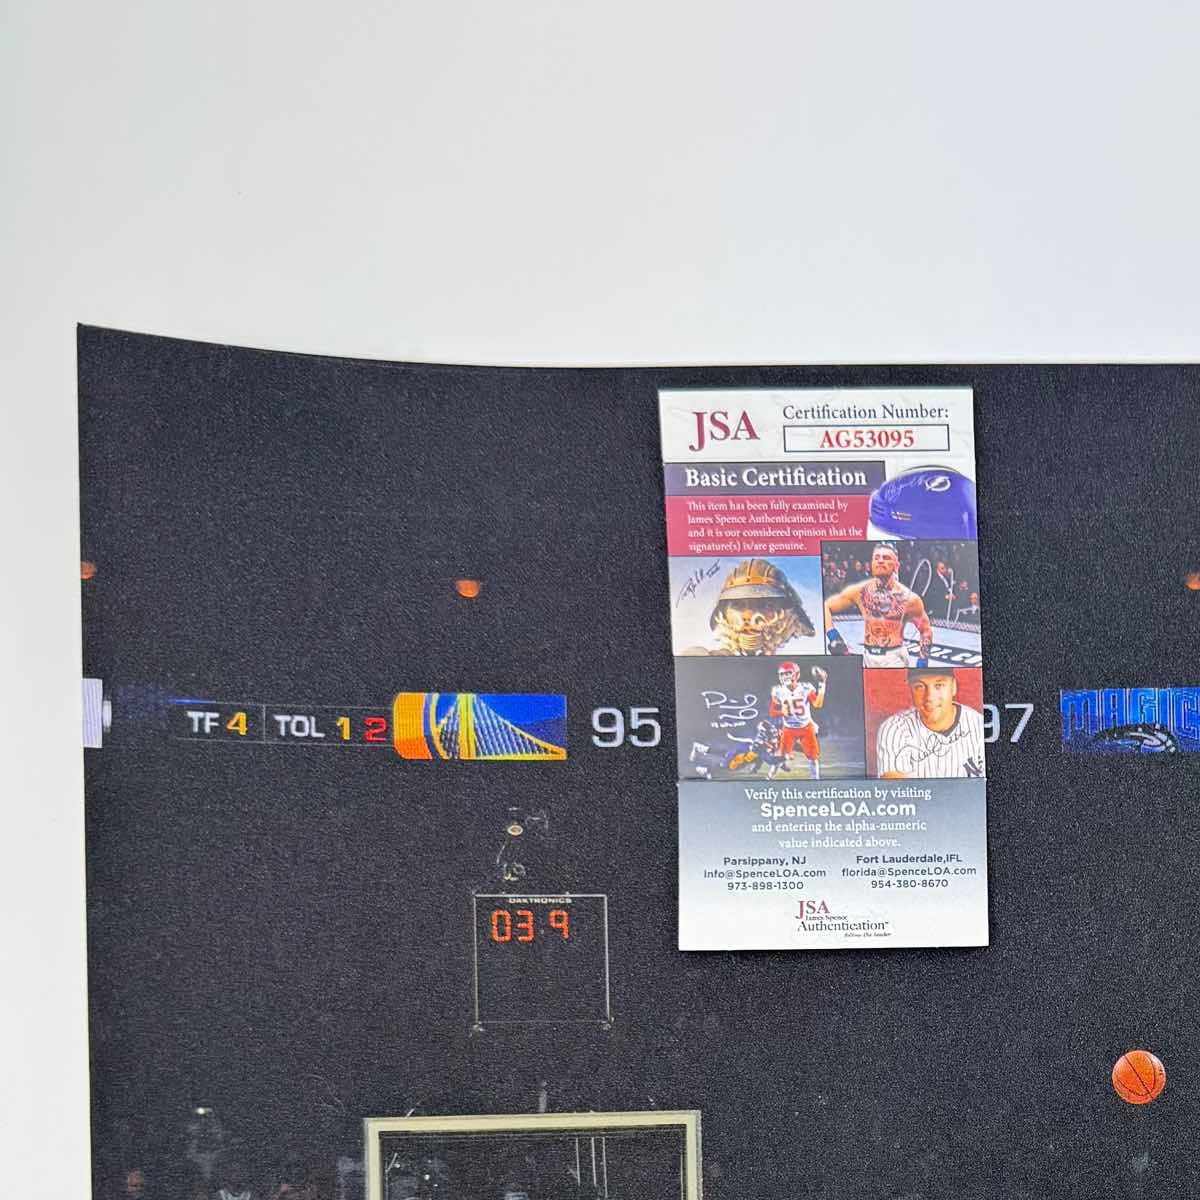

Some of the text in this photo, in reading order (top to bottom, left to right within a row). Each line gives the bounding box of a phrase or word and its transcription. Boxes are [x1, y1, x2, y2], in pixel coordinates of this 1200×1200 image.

[783, 404, 949, 420] Certification Number:
[689, 411, 760, 452] JSA
[820, 429, 914, 449] AG53095
[685, 466, 867, 487] Basic Certification
[688, 500, 849, 513] This item has been fully examined by
[688, 514, 713, 525] James
[715, 514, 747, 526] Spence
[818, 513, 839, 524] LLC
[688, 527, 863, 539] and it is our considered opinion that the
[187, 711, 248, 736] TF 4
[274, 715, 387, 743] TOL 1 2
[591, 706, 662, 748] 95
[744, 787, 932, 802] Verify this certification by visiting
[760, 801, 917, 820] SpenceLOA.com
[752, 820, 927, 836] and entering the alpha-numeric
[778, 836, 902, 849] value indicated above.
[723, 856, 807, 867] Parsippany, NJ
[856, 855, 879, 864] Fort
[842, 866, 977, 878] florida@SpenceLOA.com
[727, 881, 805, 891] 973-898-1300
[871, 878, 949, 889] 954-380-8670
[795, 900, 831, 920] JSA
